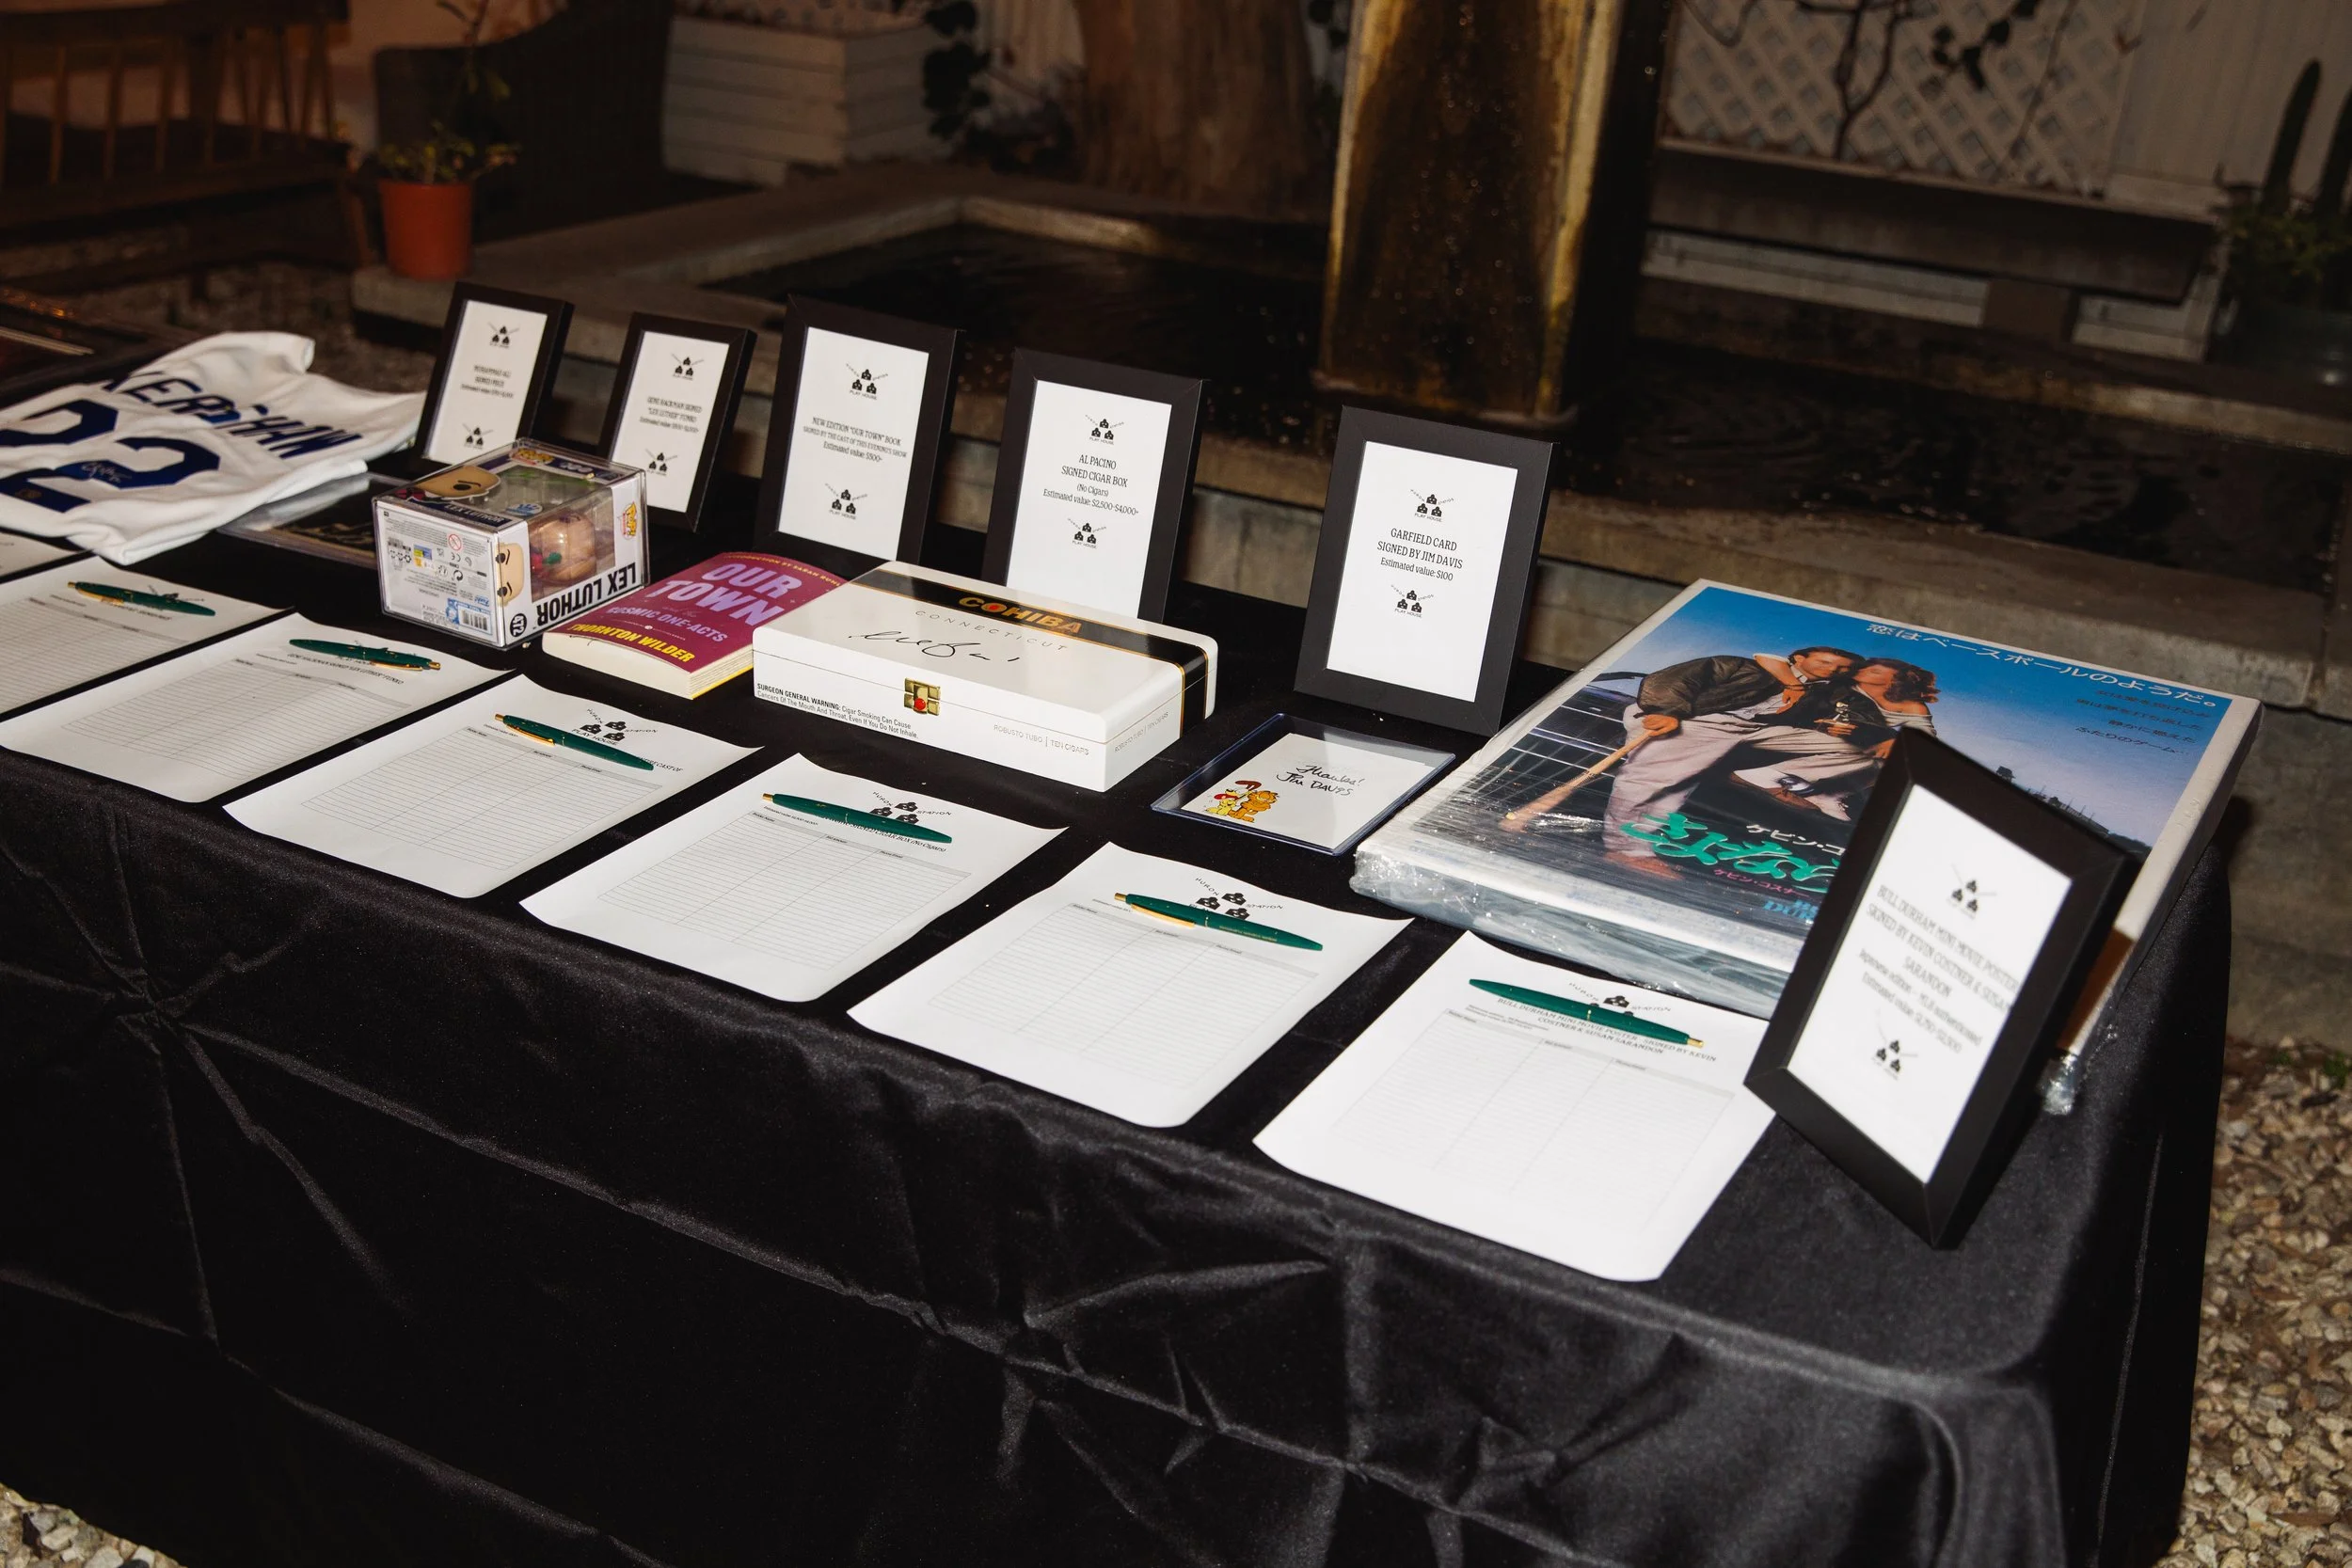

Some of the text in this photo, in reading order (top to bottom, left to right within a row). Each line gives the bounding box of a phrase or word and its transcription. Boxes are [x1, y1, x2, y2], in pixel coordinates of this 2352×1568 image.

[812, 417, 825, 427] NEW
[826, 420, 849, 433] EDITION
[884, 436, 901, 446] BOOK
[823, 440, 850, 455] Estimated
[1079, 454, 1117, 470] AL PACINO
[1061, 466, 1128, 488] SIGNED CIGAR BOX
[1076, 483, 1109, 498] (No Cigars)
[1042, 488, 1073, 502] Estimated
[1073, 495, 1091, 507] value:
[1391, 528, 1457, 552] GARFIELD CARD
[1376, 540, 1464, 570] SIGNED BY JIM DAVIS
[1380, 557, 1454, 581] Estimated value: $100
[701, 562, 803, 599] OUR
[792, 565, 819, 578] SARAH
[536, 562, 636, 626] LEX LUTHOR
[644, 578, 785, 626] TOWN
[607, 606, 659, 620] COSMIC
[658, 613, 728, 643] ONE-ACTS
[959, 595, 1082, 634] COHIBA
[566, 624, 641, 642] THORNTON
[638, 634, 696, 664] WILDER
[914, 610, 1069, 652] CONNECTICUT
[1866, 623, 2217, 708] 恋はベースボールのようだ。
[756, 683, 912, 729] SURGEON GENERAL WARNING: Cigar Smoking Can Cause
[756, 690, 779, 702] Cancers
[787, 698, 798, 707] The
[798, 701, 817, 712] Mouth
[817, 706, 828, 716] And
[849, 714, 862, 723] Even
[867, 720, 879, 728] You
[879, 722, 888, 731] Do
[888, 725, 899, 734] Not
[899, 727, 919, 739] Inhale.
[572, 729, 618, 746] PLAY HOUSE
[993, 724, 1025, 738] ROBUSTO
[1025, 733, 1043, 743] TUBO
[1050, 739, 1064, 750] TEN
[872, 791, 893, 807] HURON
[1195, 878, 1220, 896] HURON
[1498, 998, 1518, 1009] BULL
[1676, 1045, 1688, 1054] BY
[1690, 1049, 1718, 1062] KEVIN
[1537, 1017, 1576, 1031] COSTNER
[1584, 1029, 1614, 1041] SUSAN
[1615, 1037, 1664, 1054] SARANDON
